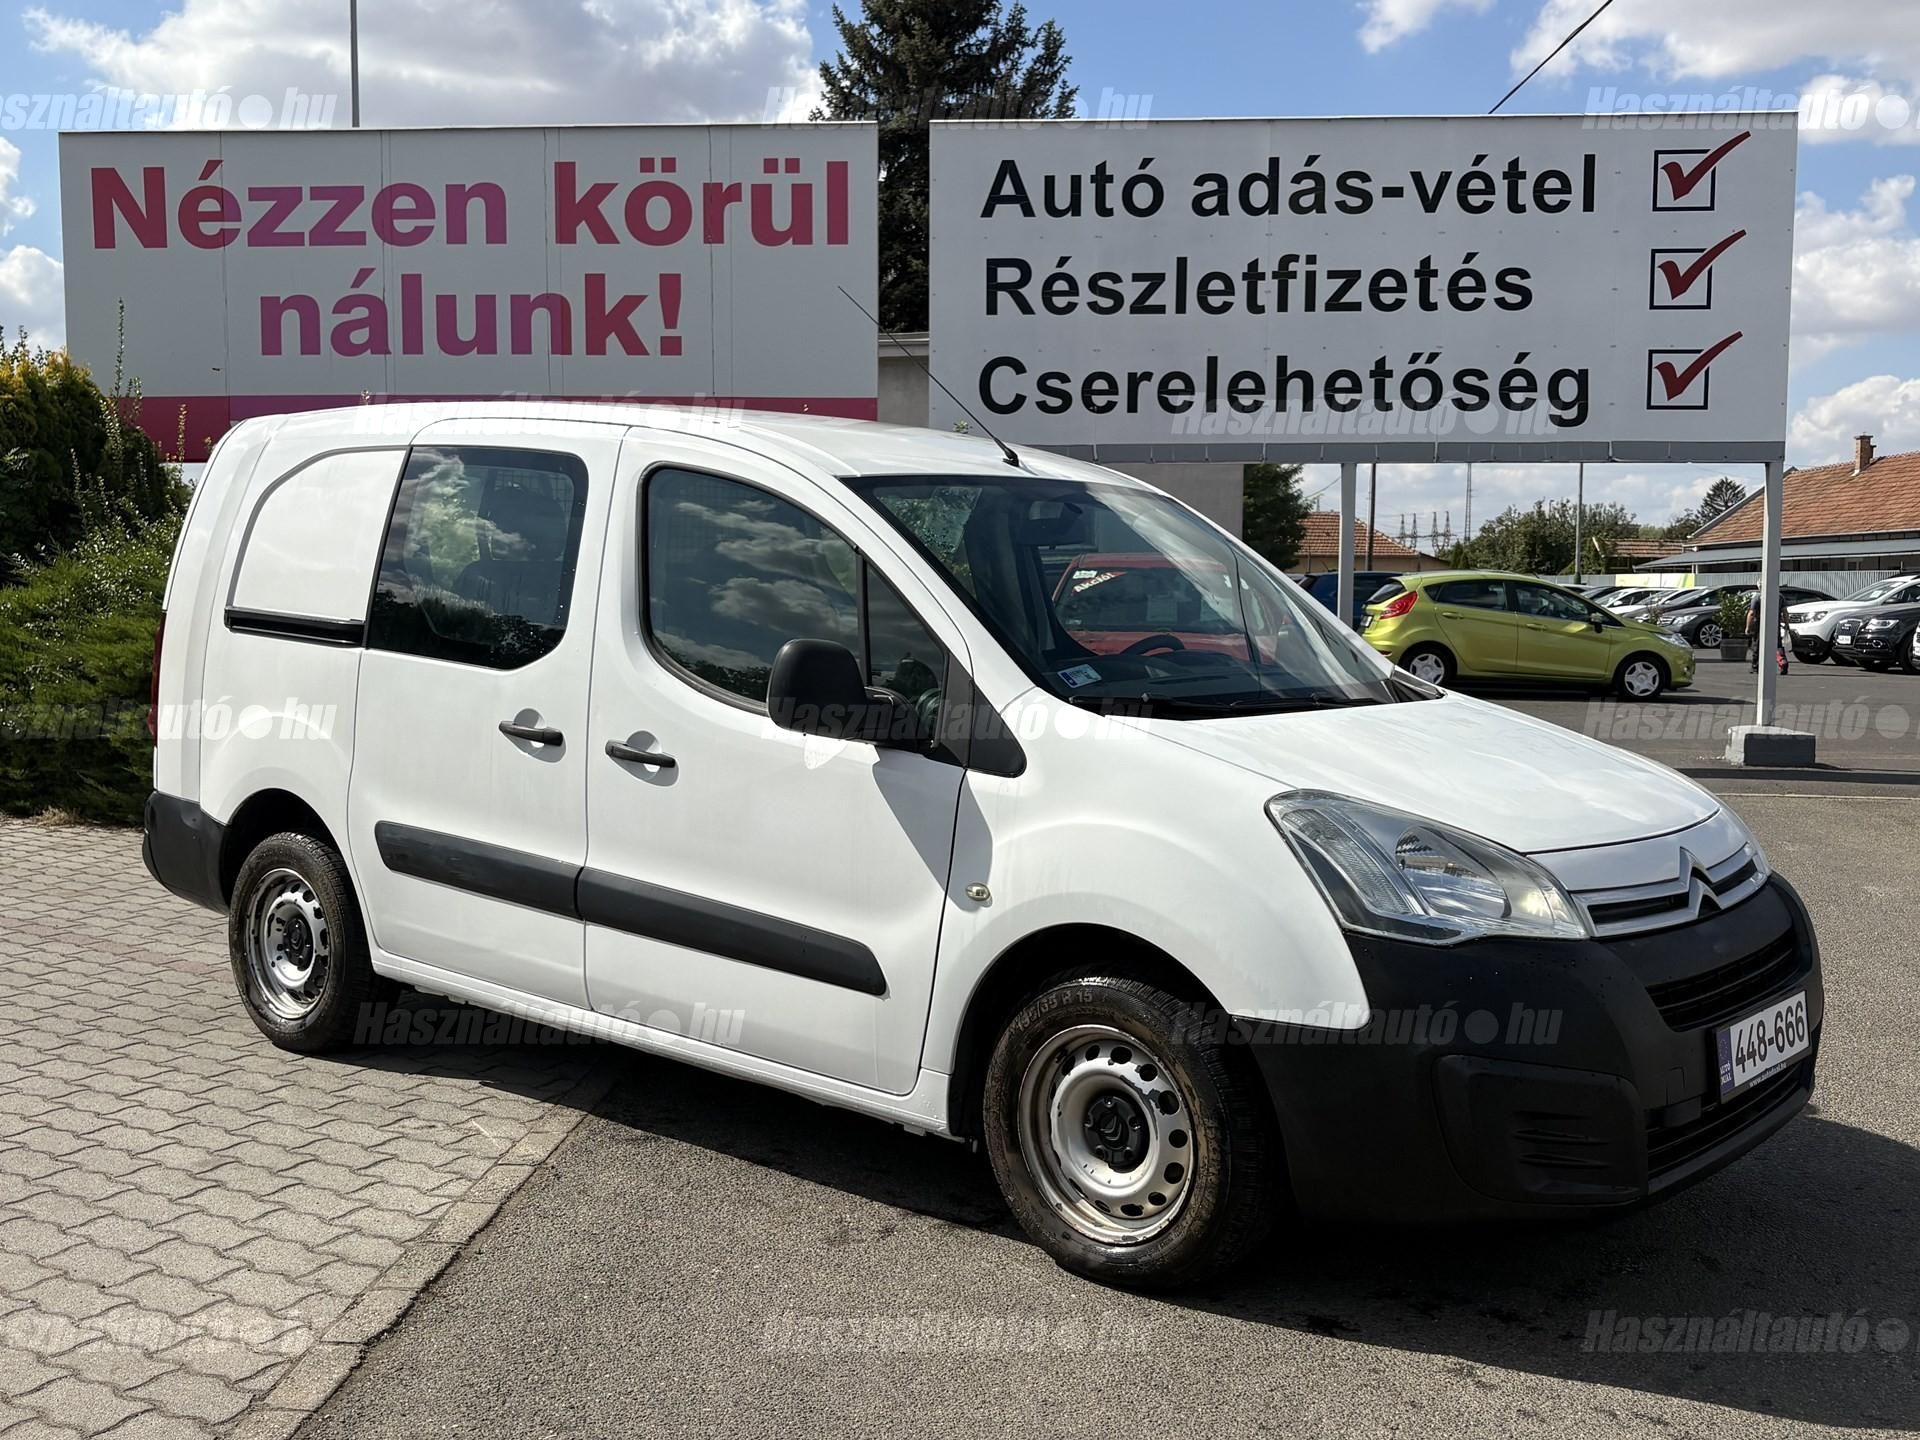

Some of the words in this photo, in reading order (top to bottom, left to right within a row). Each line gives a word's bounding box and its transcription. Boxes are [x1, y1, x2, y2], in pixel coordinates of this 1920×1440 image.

[91, 160, 507, 250] Nézzen
[555, 157, 848, 247] körül
[980, 157, 1165, 218] Autó
[1191, 153, 1596, 218] adás-vétel
[260, 268, 683, 356] nálunk!
[985, 252, 1533, 316] Részletfizetés
[979, 354, 1590, 427] Cserelehetőség
[1735, 1000, 1805, 1074] 448-666
